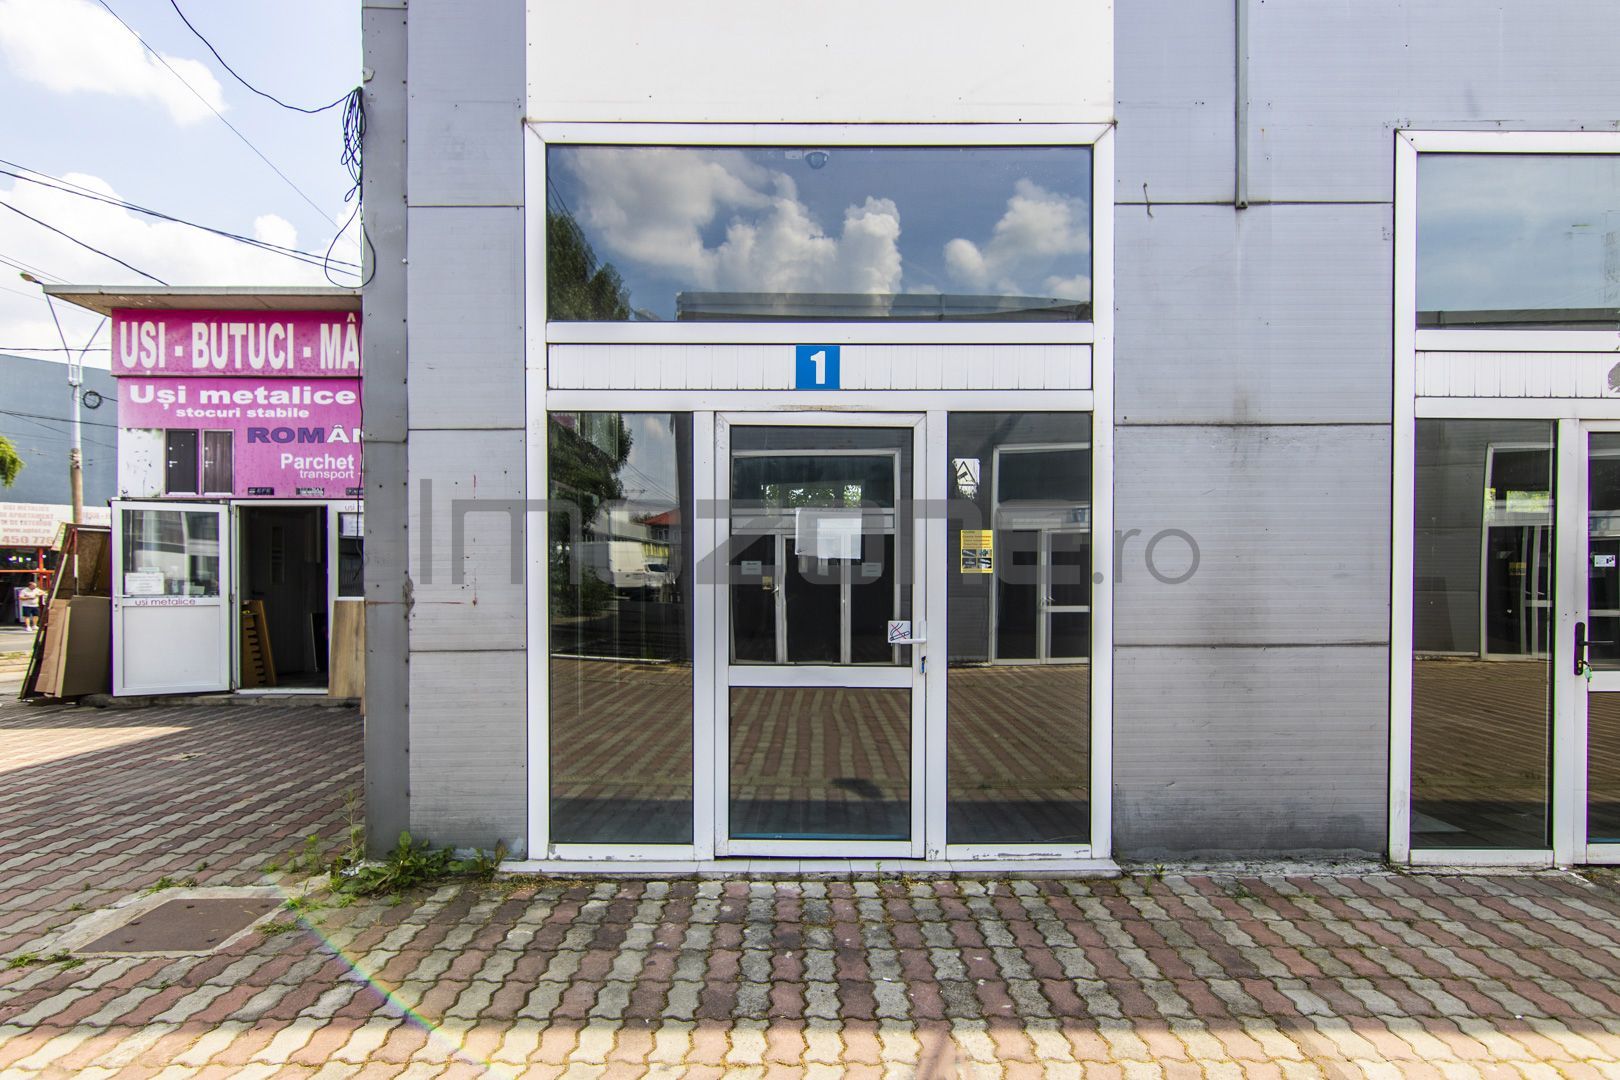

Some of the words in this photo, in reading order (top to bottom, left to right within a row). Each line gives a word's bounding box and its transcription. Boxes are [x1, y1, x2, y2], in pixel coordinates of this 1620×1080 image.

[191, 322, 295, 370] BUTUCI
[810, 350, 826, 385] 1
[129, 385, 187, 410] Uși
[199, 386, 357, 405] metalice
[175, 406, 241, 418] stocuri
[246, 406, 310, 418] stabile
[280, 453, 355, 470] Parchet
[299, 469, 355, 481] transport
[150, 597, 197, 606] metalice
